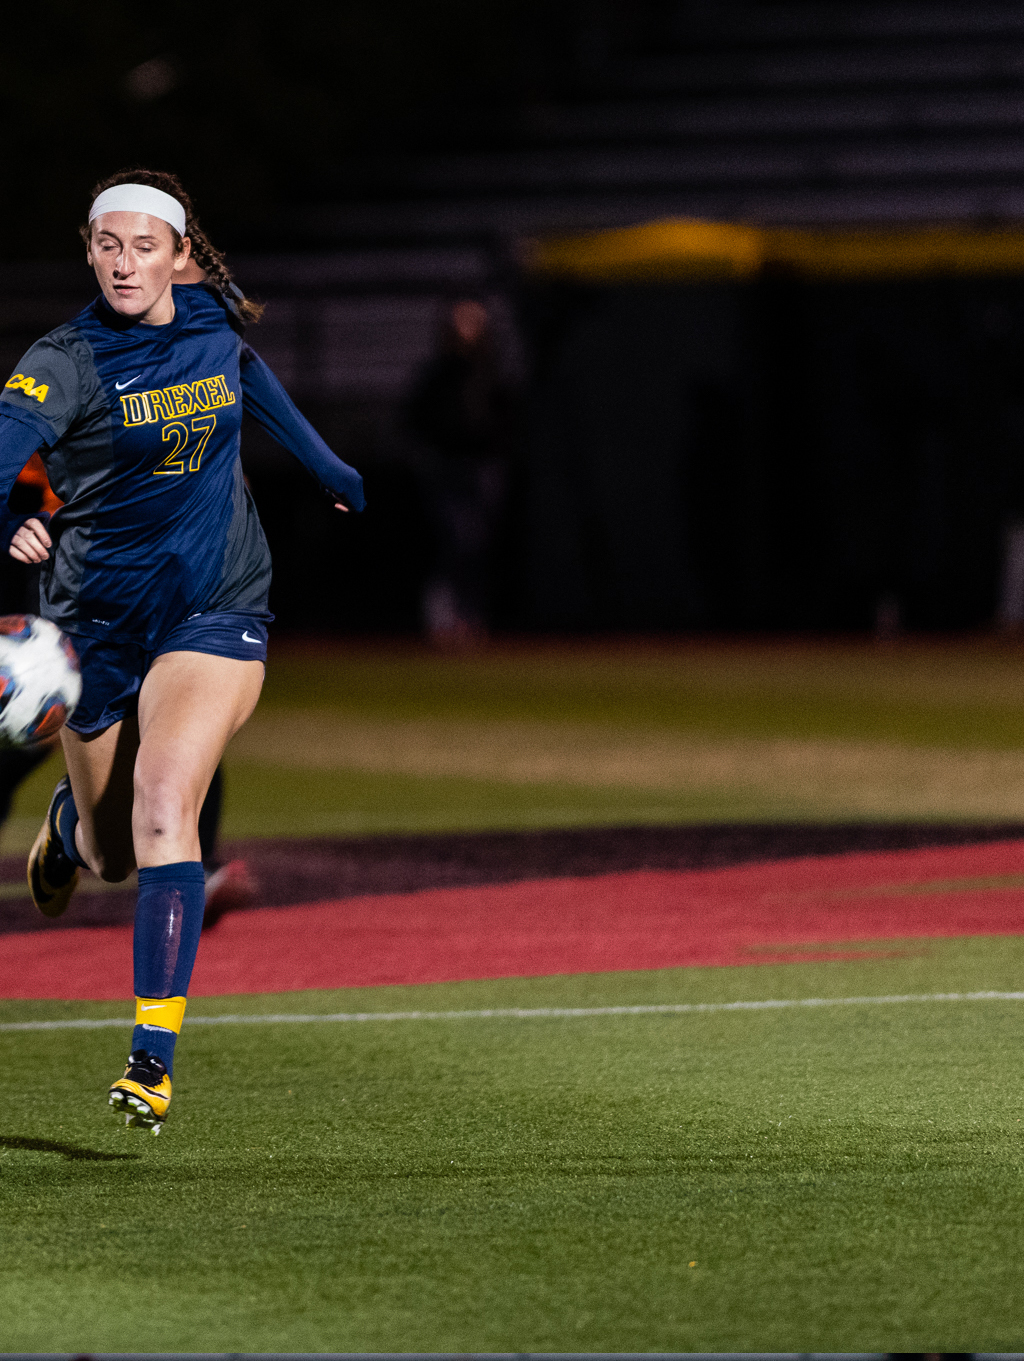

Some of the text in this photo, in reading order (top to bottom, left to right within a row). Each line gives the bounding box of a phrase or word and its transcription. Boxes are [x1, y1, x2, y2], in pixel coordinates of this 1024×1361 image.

[5, 373, 50, 404] CAA
[119, 373, 236, 428] DREXEL
[152, 414, 217, 475] 27
